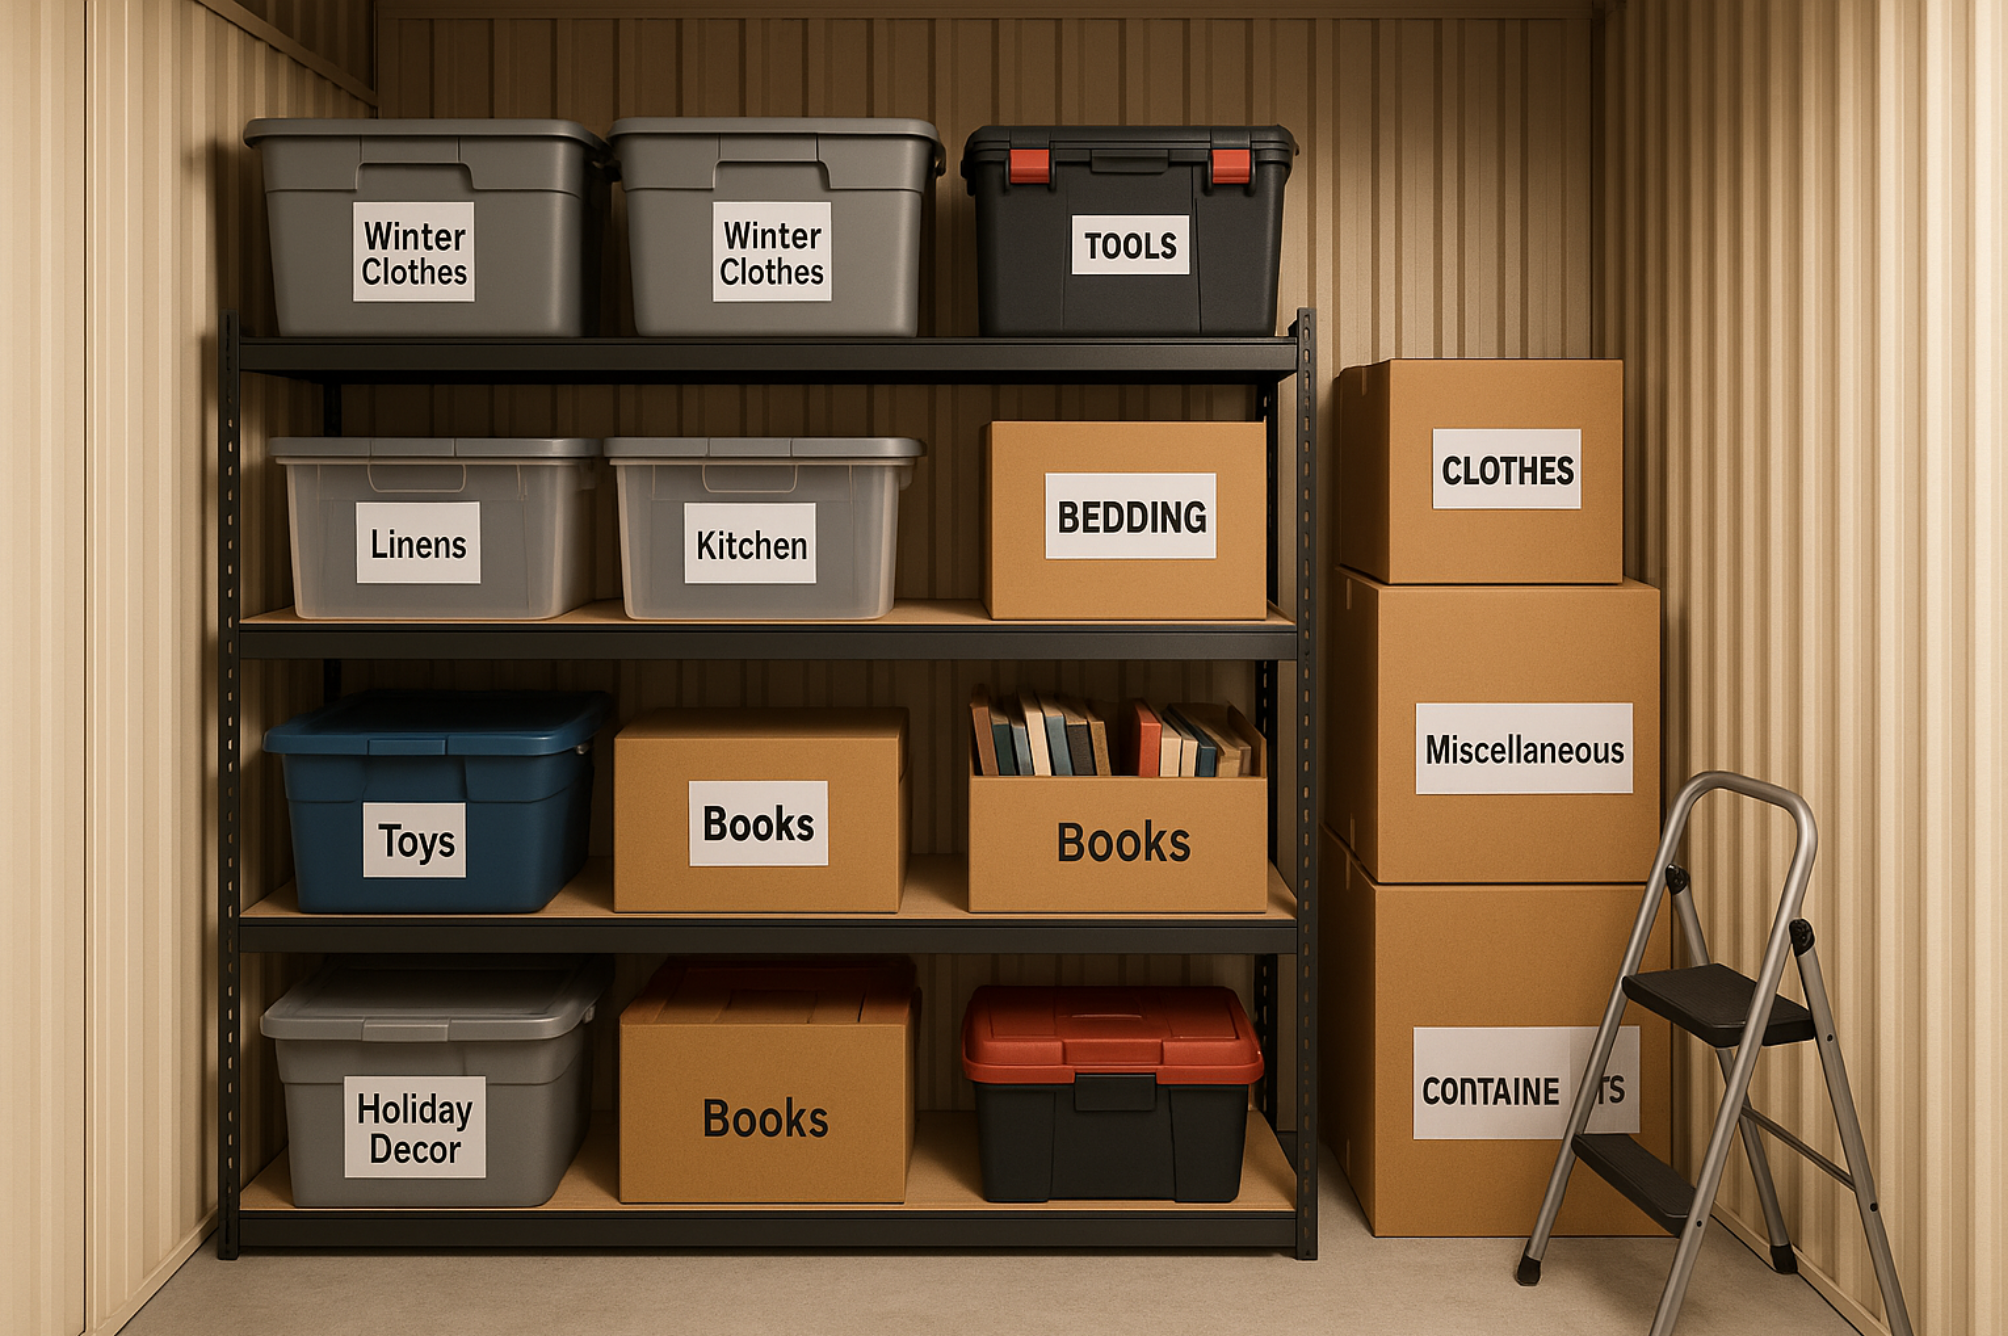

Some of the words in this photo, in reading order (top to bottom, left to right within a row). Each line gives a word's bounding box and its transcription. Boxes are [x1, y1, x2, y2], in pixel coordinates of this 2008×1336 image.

[364, 221, 466, 251] Winter
[723, 221, 822, 250] Winter
[1084, 231, 1177, 260] TOOLS
[362, 256, 467, 286] Clothes
[720, 256, 824, 286] Clothes
[1442, 455, 1575, 486] CLOTHES
[1058, 500, 1207, 534] BEDDING
[372, 528, 467, 560] Linens
[697, 529, 807, 560] Kitchen
[1426, 733, 1625, 765] Miscellaneous
[704, 804, 815, 842] Books
[378, 823, 455, 866] Toys
[1058, 819, 1191, 863] Books
[358, 1092, 473, 1132] Holiday
[704, 1096, 829, 1138] Books
[370, 1133, 462, 1164] Decor
